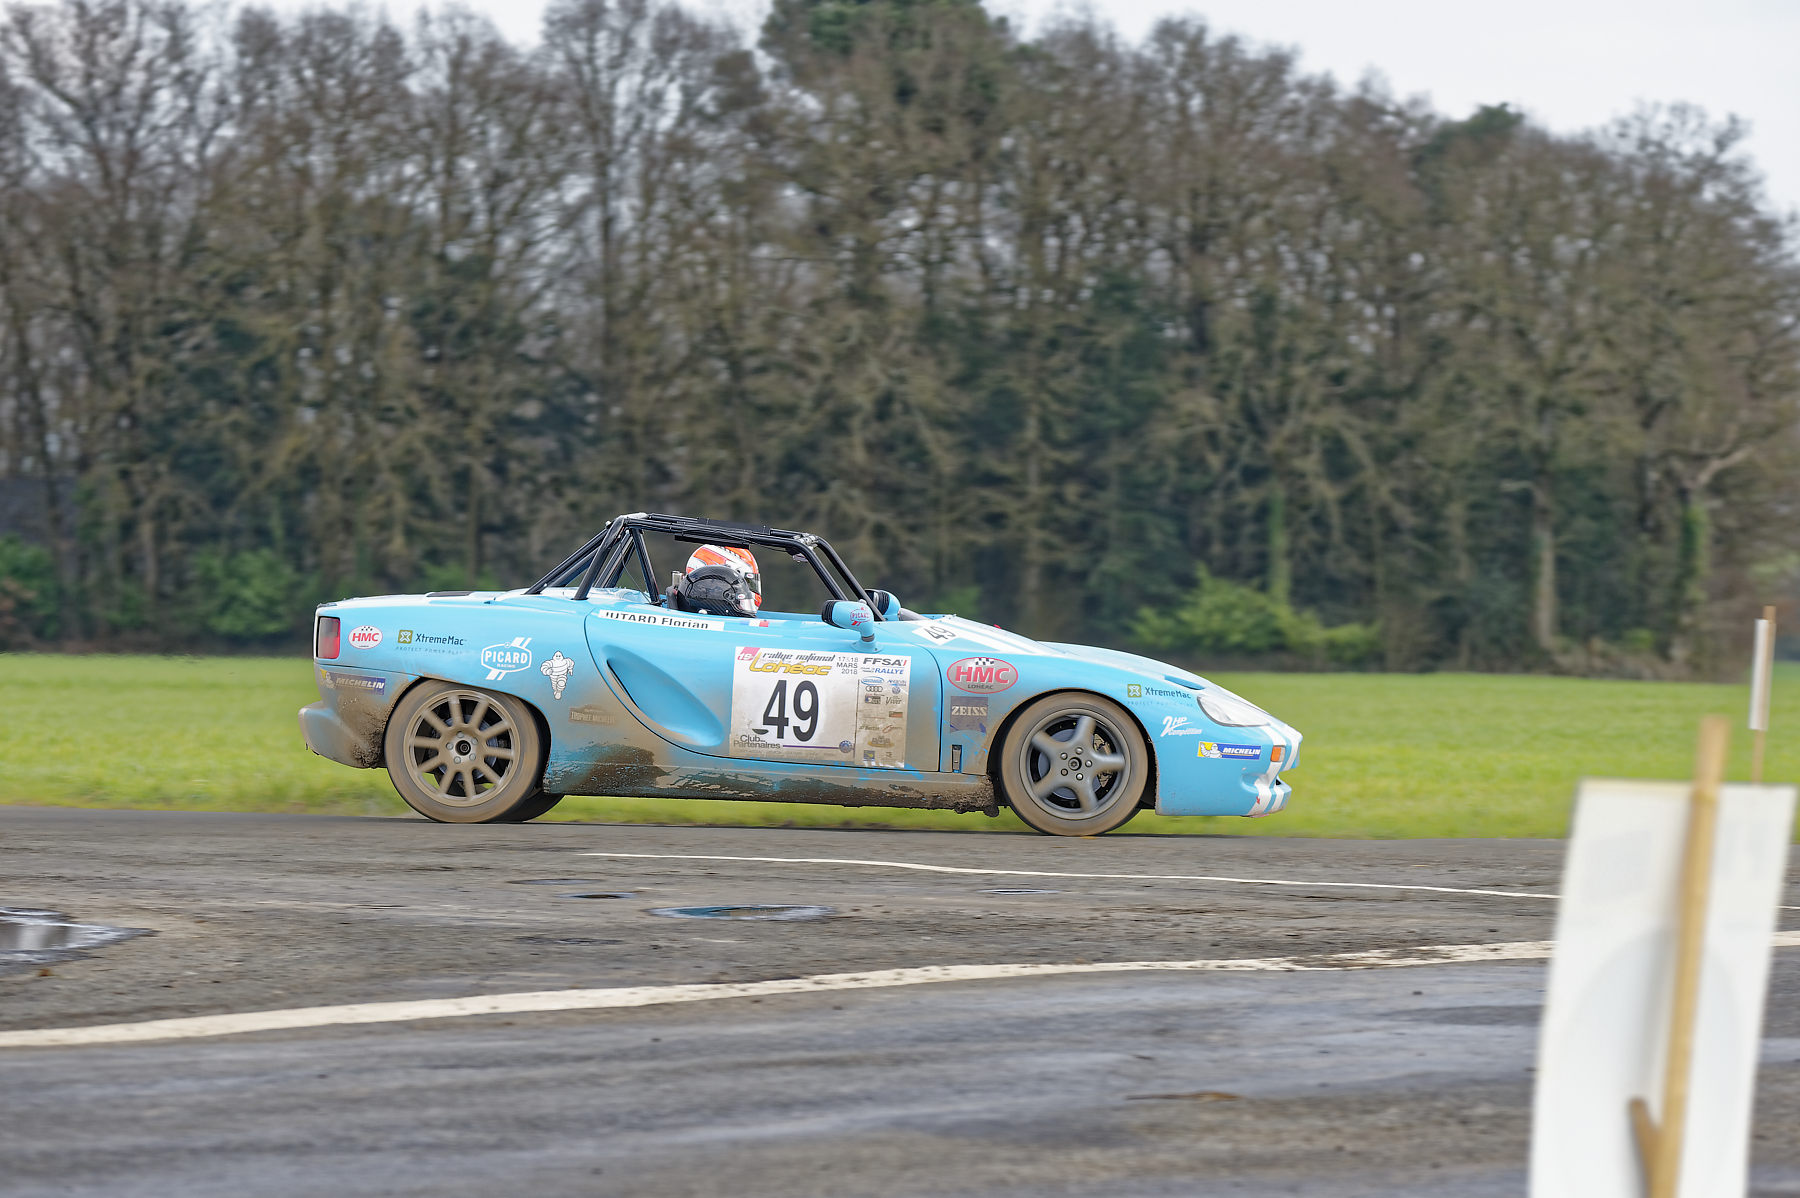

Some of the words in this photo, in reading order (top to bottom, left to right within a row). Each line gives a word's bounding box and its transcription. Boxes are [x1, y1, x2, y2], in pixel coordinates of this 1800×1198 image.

[661, 617, 709, 629] Florian
[352, 633, 380, 642] HMC
[923, 626, 956, 640] 49
[415, 633, 464, 646] XtremeMac
[485, 651, 528, 664] PICARD
[762, 652, 793, 661] rallye
[796, 653, 836, 663] national
[863, 657, 901, 666] FFSA
[749, 652, 832, 676] Lohéac
[955, 666, 1010, 684] HMC
[336, 678, 385, 689] MICHELIN
[1145, 687, 1191, 699] XtremeMac
[762, 679, 819, 742] 49
[951, 705, 987, 716] ZEISS
[733, 739, 780, 749] Partenaires
[1222, 747, 1260, 755] MICHELIN
